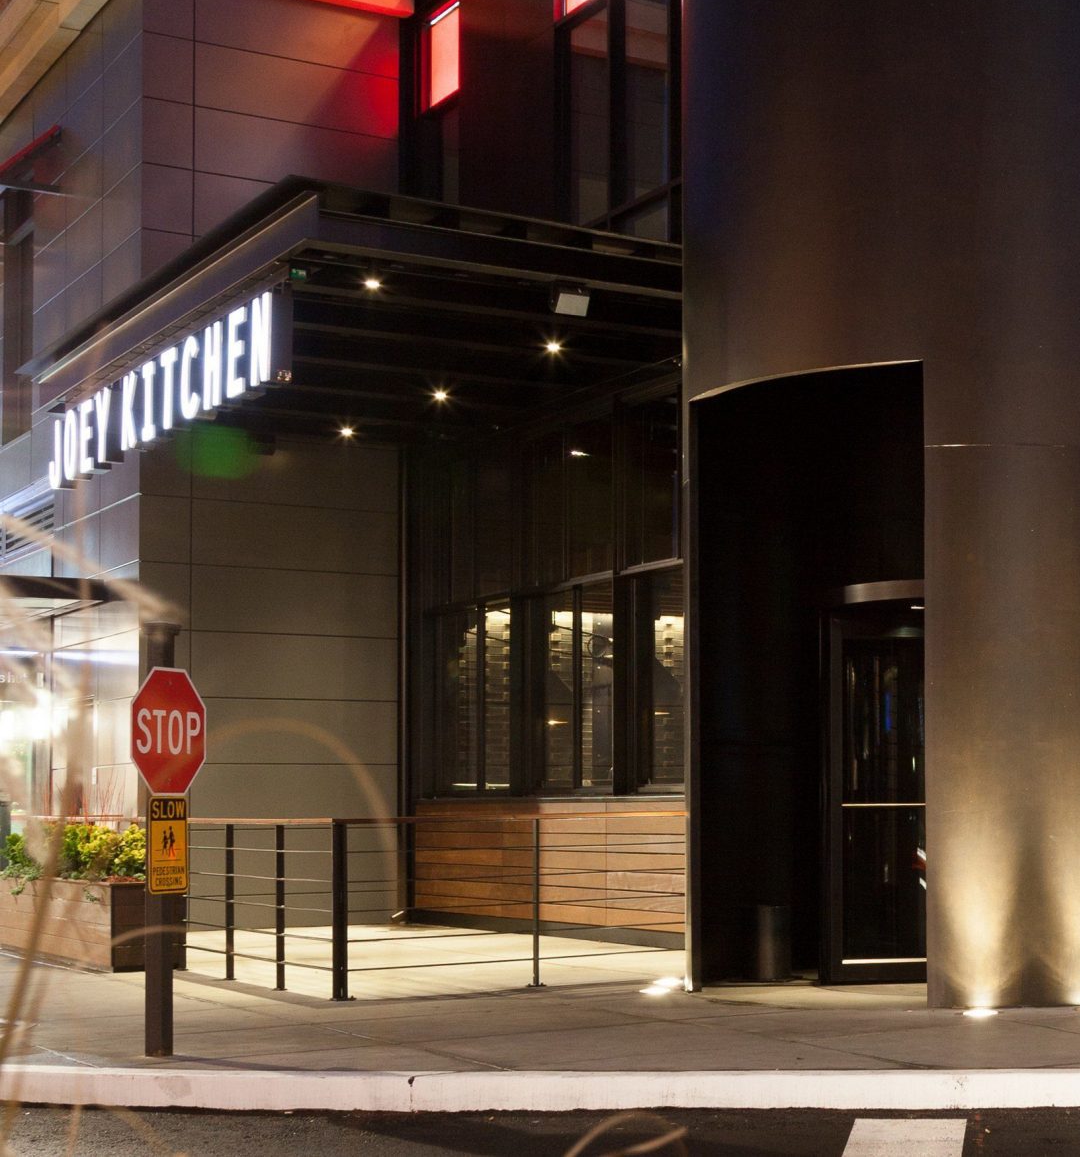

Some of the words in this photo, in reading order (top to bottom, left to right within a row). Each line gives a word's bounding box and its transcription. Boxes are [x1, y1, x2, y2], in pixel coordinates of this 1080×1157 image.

[49, 387, 112, 490] JOEY
[120, 291, 273, 451] KITCHEN
[136, 708, 201, 755] STOP
[152, 801, 185, 819] SLOW
[153, 865, 185, 876] PEDESTRIAN
[156, 876, 182, 887] CROSSING
